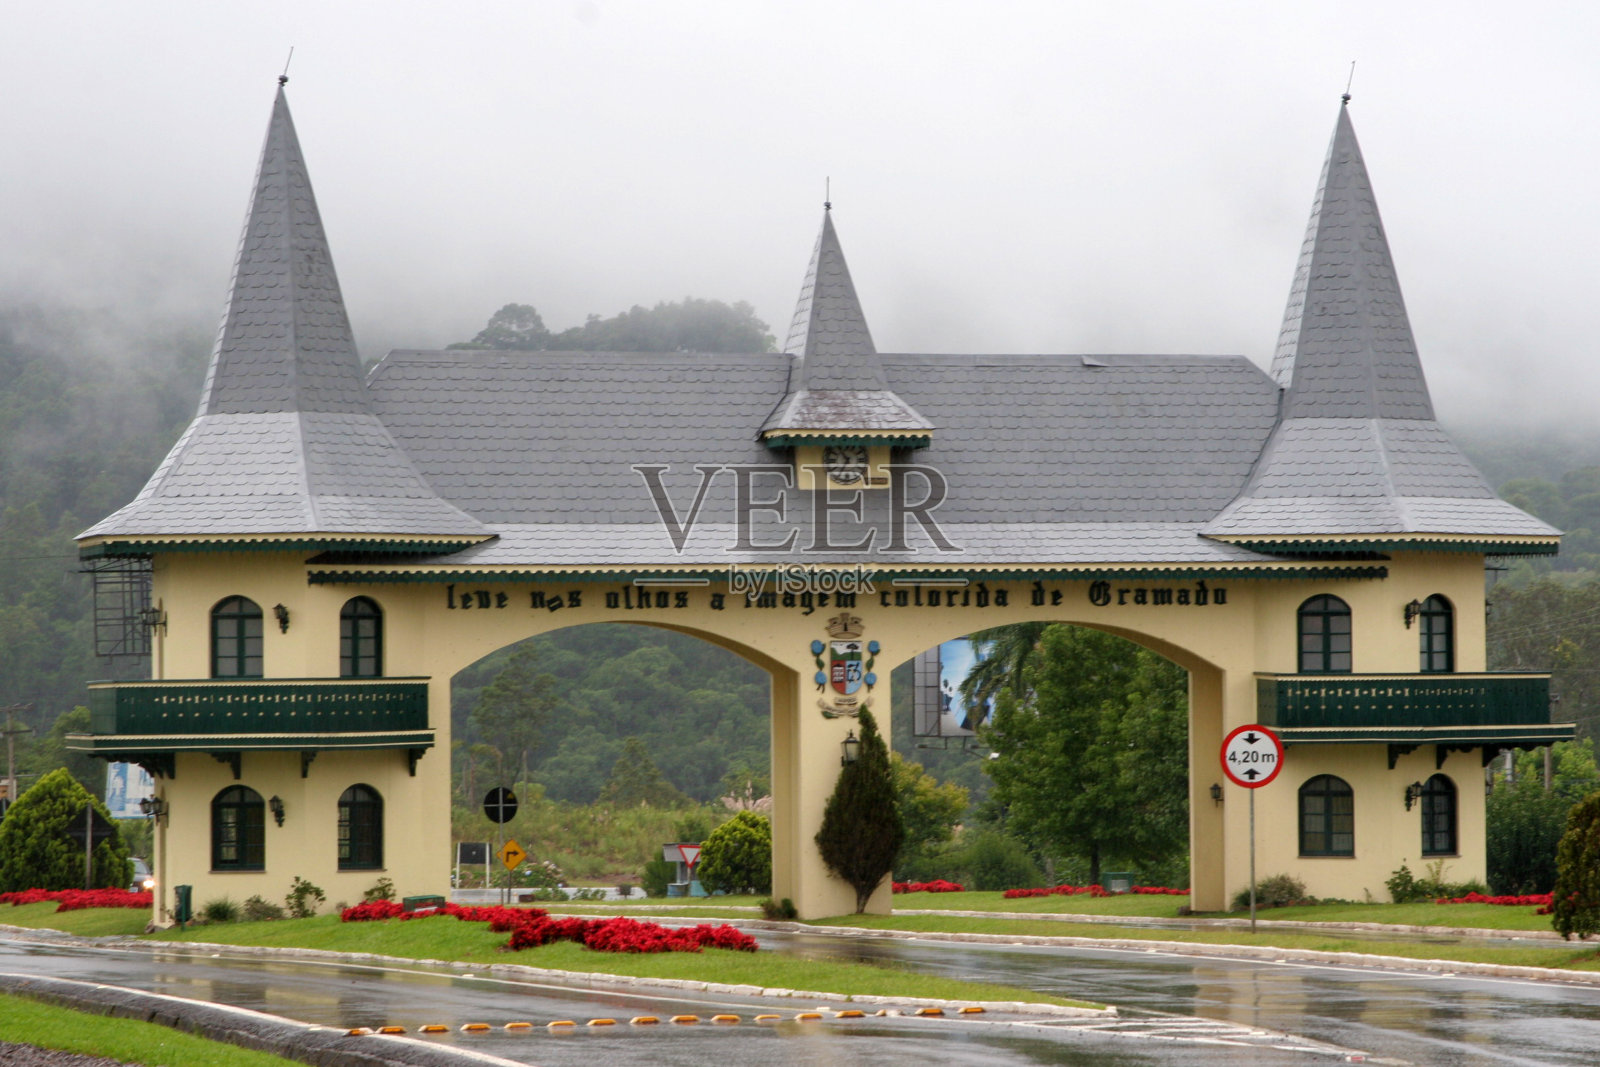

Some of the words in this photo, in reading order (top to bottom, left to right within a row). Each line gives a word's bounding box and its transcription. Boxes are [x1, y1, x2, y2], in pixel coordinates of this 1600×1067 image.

[446, 584, 509, 609] leve
[530, 590, 582, 612] nos
[605, 585, 688, 609] olhos
[710, 592, 725, 610] a
[880, 582, 1009, 608] colorida
[1031, 580, 1063, 607] de
[1088, 579, 1228, 607] Gramado
